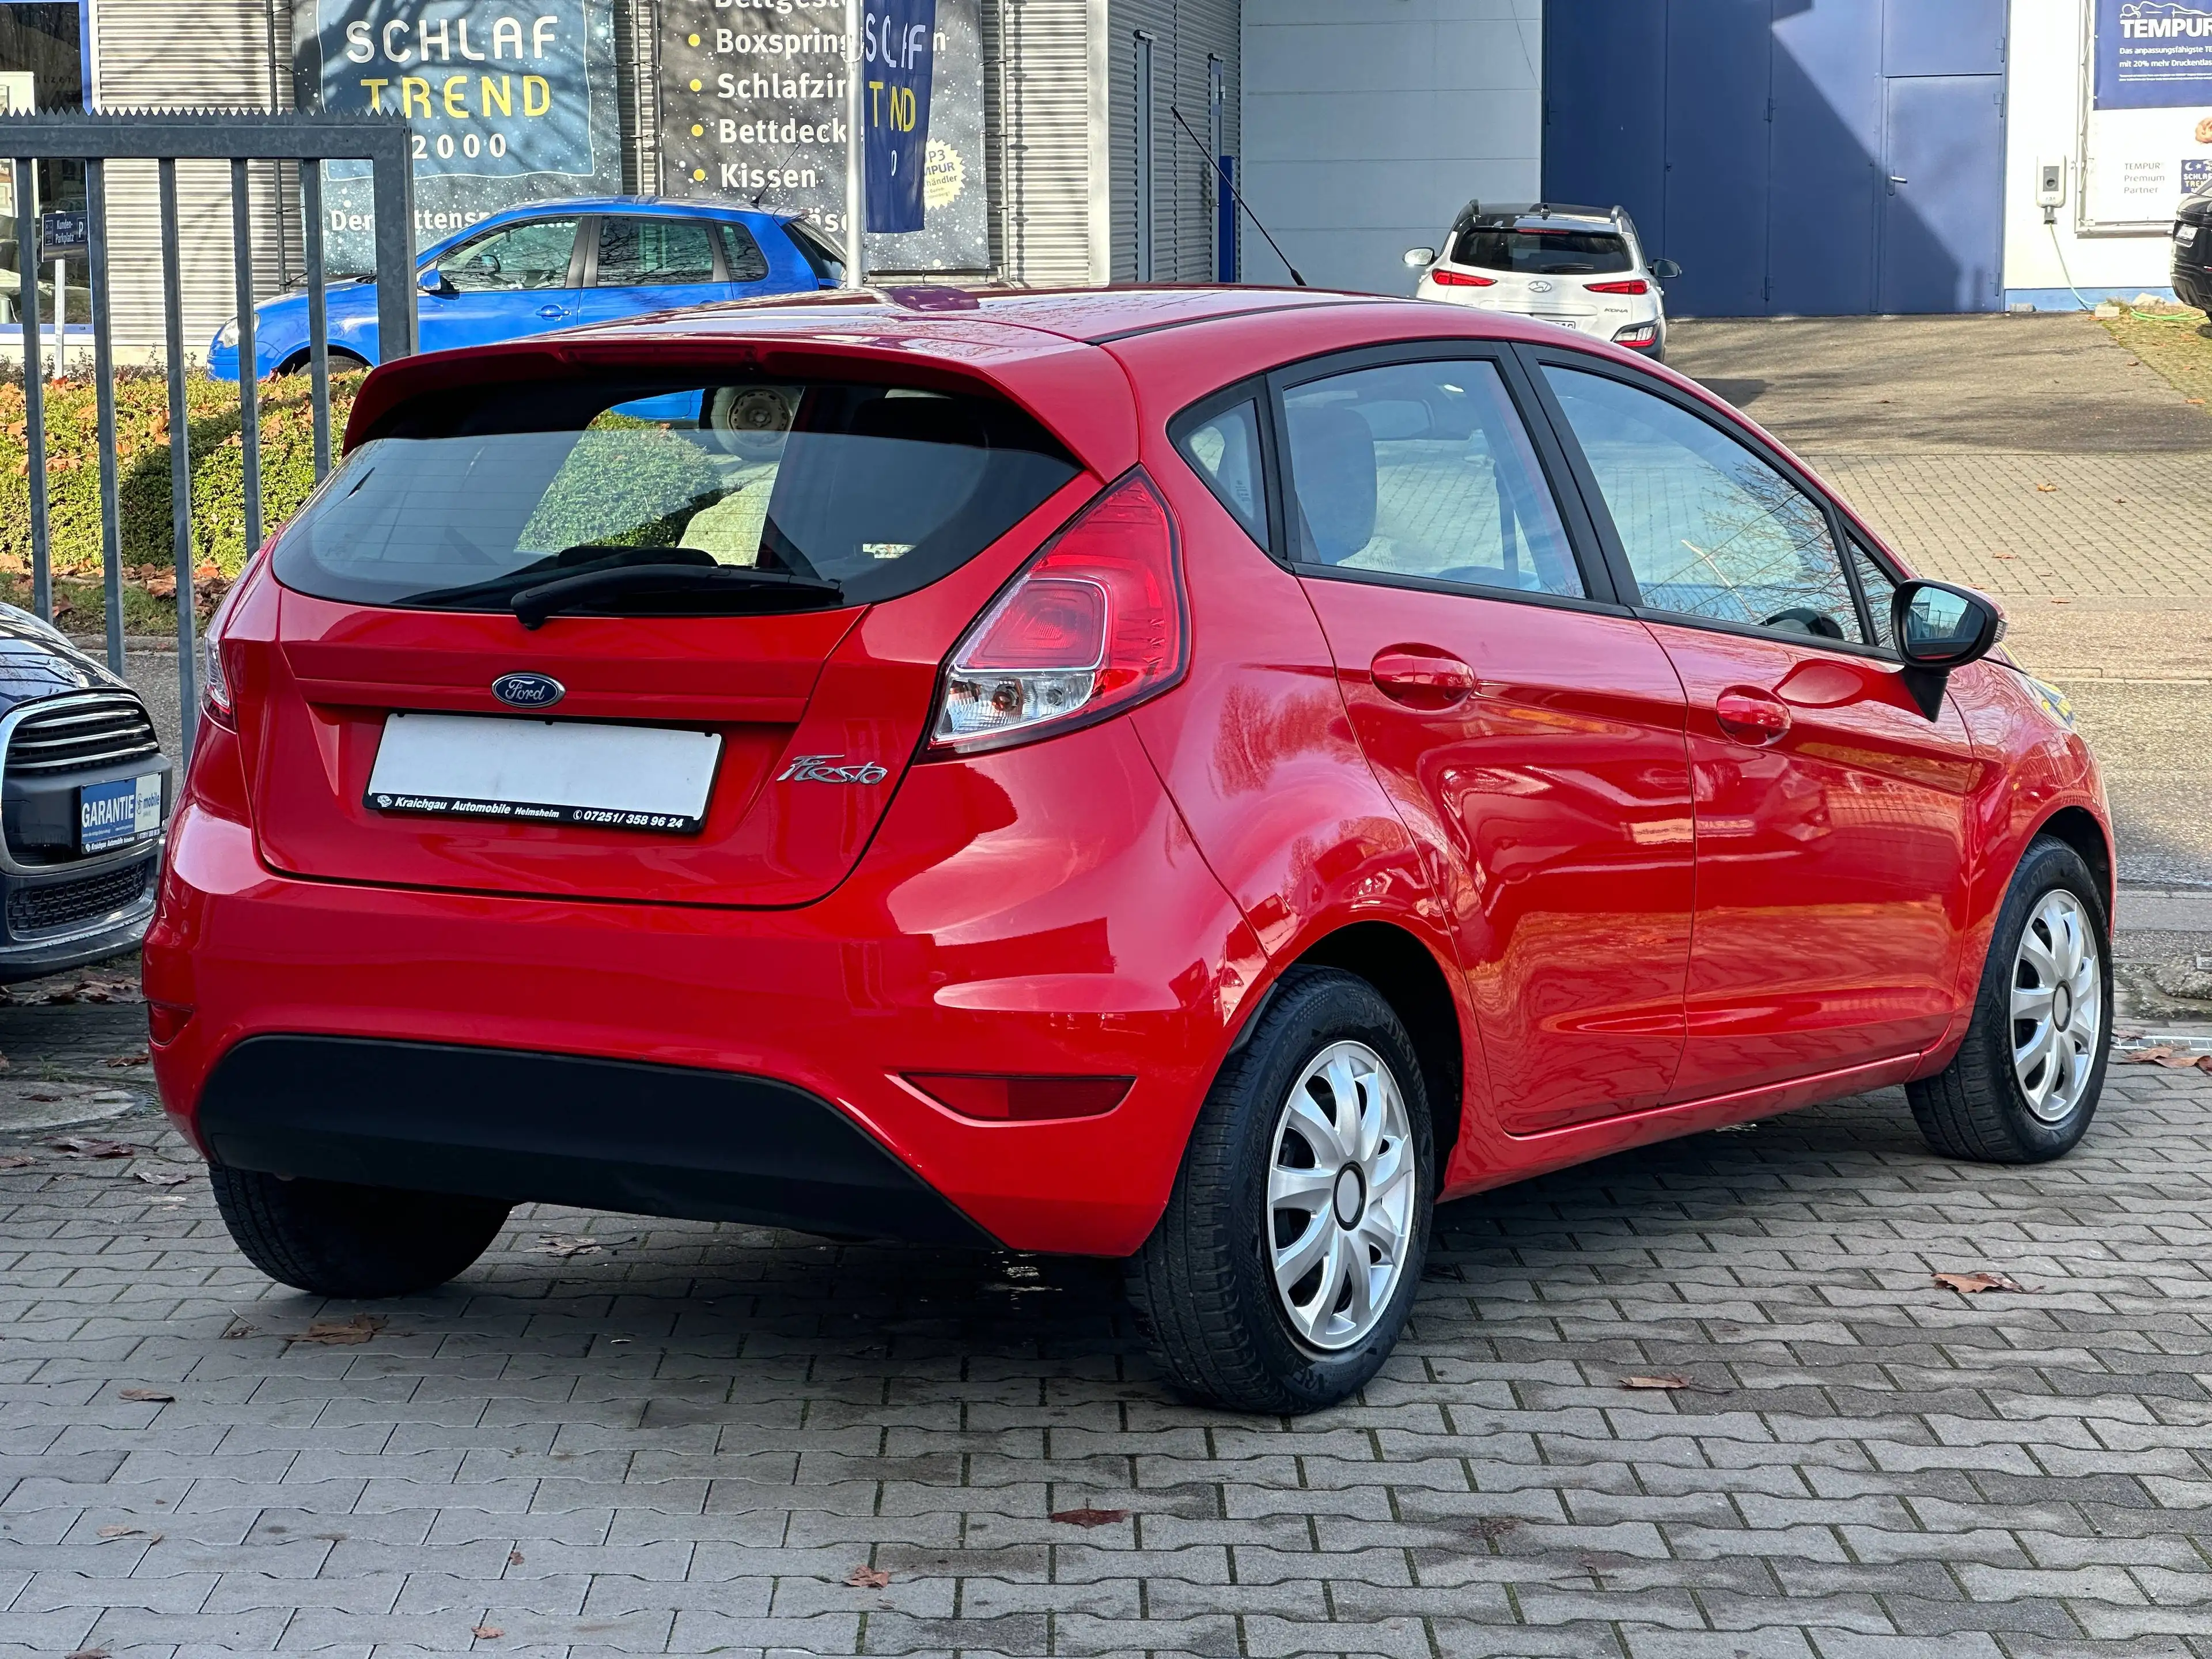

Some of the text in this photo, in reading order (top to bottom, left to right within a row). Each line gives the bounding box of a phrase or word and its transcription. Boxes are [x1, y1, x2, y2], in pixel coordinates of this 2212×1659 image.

[346, 16, 558, 63] SCHLAF
[2135, 46, 2203, 55] anpassungsfähigste
[361, 75, 551, 119] TREND
[412, 133, 506, 159] 2000
[721, 162, 816, 188] Kissen
[926, 175, 957, 187] händler
[331, 210, 373, 230] Der
[505, 679, 545, 700] Ford
[777, 755, 888, 784] Fiesta
[82, 794, 135, 828] GARANTIE
[395, 797, 684, 828] Kraichgau Automobile Helmsheim 07251/ 358 96 24
